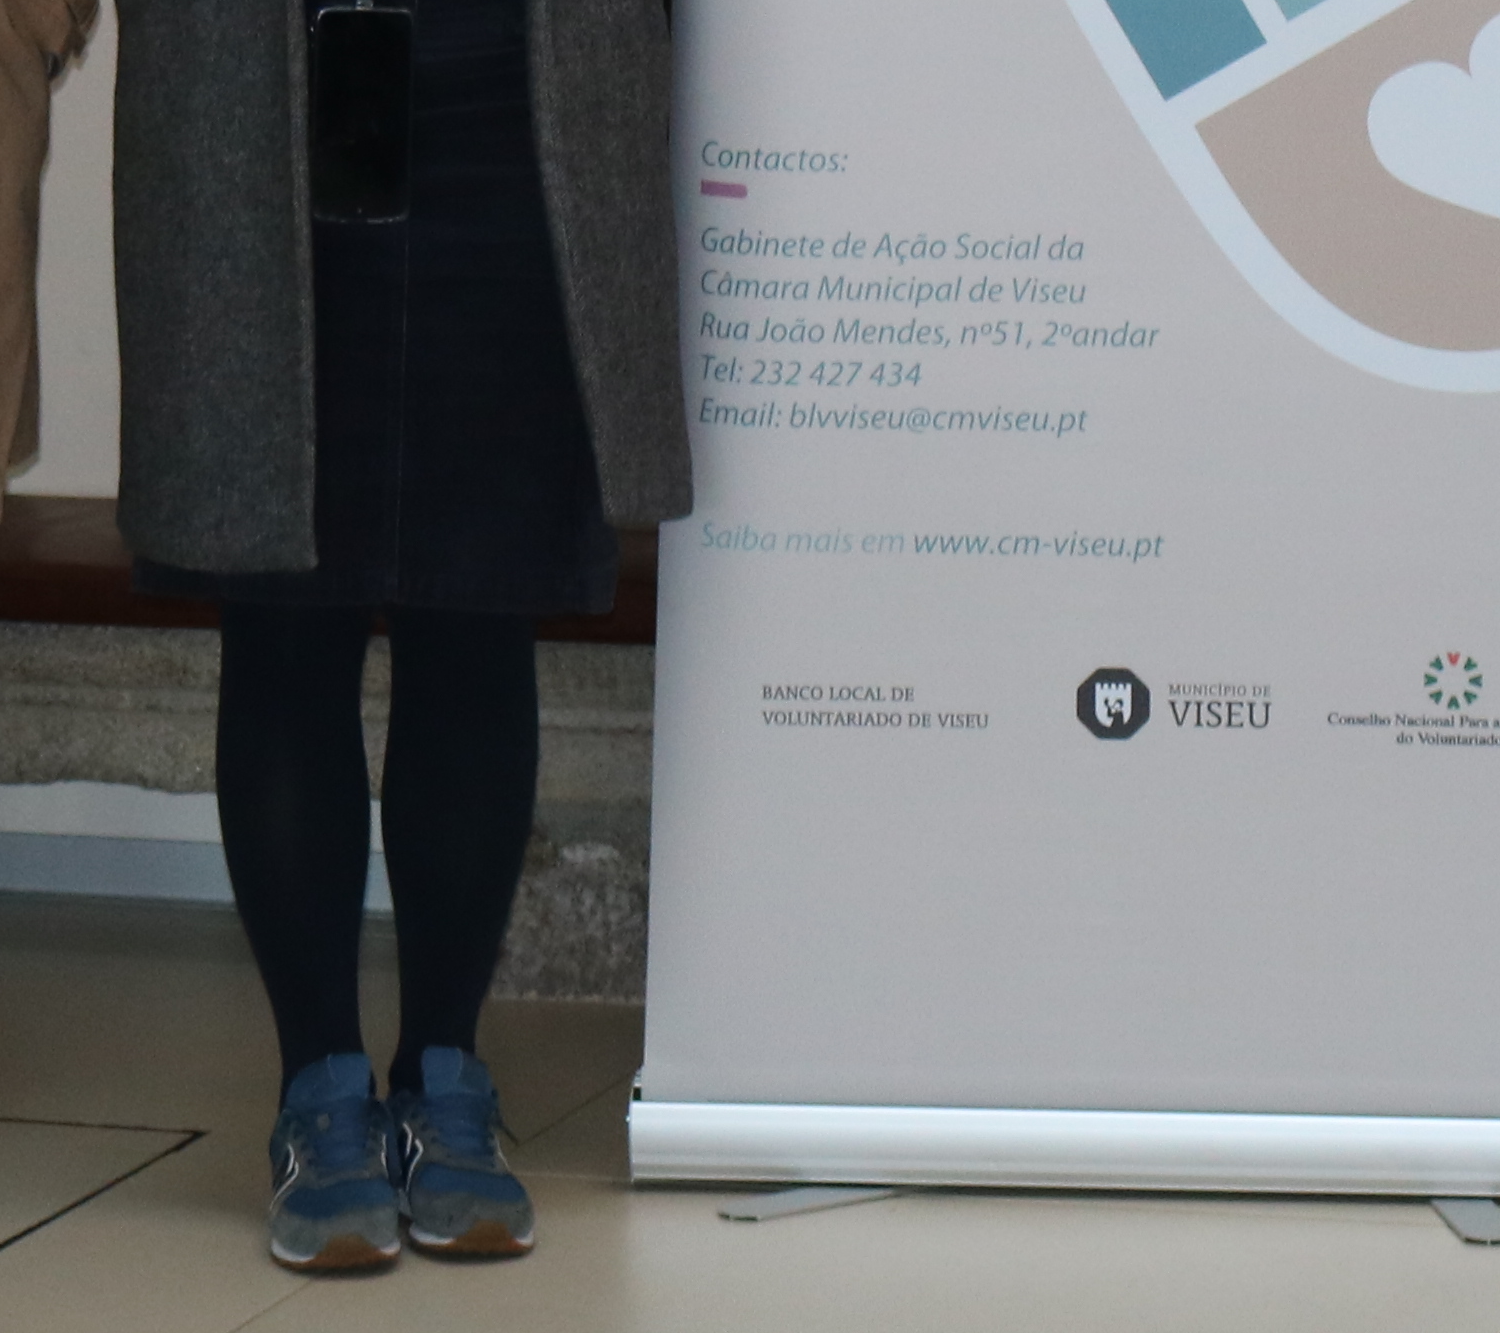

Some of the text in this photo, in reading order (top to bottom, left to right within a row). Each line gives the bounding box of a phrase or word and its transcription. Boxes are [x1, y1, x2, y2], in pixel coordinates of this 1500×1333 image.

[699, 140, 848, 174] Contactos:
[699, 226, 1084, 265] Gabinete de Ação Social da
[699, 269, 1086, 308] Câmara Municipal de Viseu
[699, 314, 1159, 349] Rua João Mendes, nº51, 2ºandar
[699, 355, 921, 387] Tel: 232 427 434
[698, 398, 1087, 438] Email: blvviseu@cmviseu.pt
[699, 522, 1164, 563] Saiba mais em www.cm-viseu.pt
[763, 685, 913, 702] BANCO LOCAL DE
[1169, 683, 1270, 697] MUNICÍPIO DE
[762, 710, 988, 728] VOLUNTARIADO DE VISEU
[1169, 700, 1270, 728] VISEU
[1327, 713, 1391, 726] Conselho
[1395, 714, 1455, 727] Nacional
[1460, 715, 1489, 728] Para
[1493, 719, 1500, 728] a
[1396, 732, 1413, 744] do
